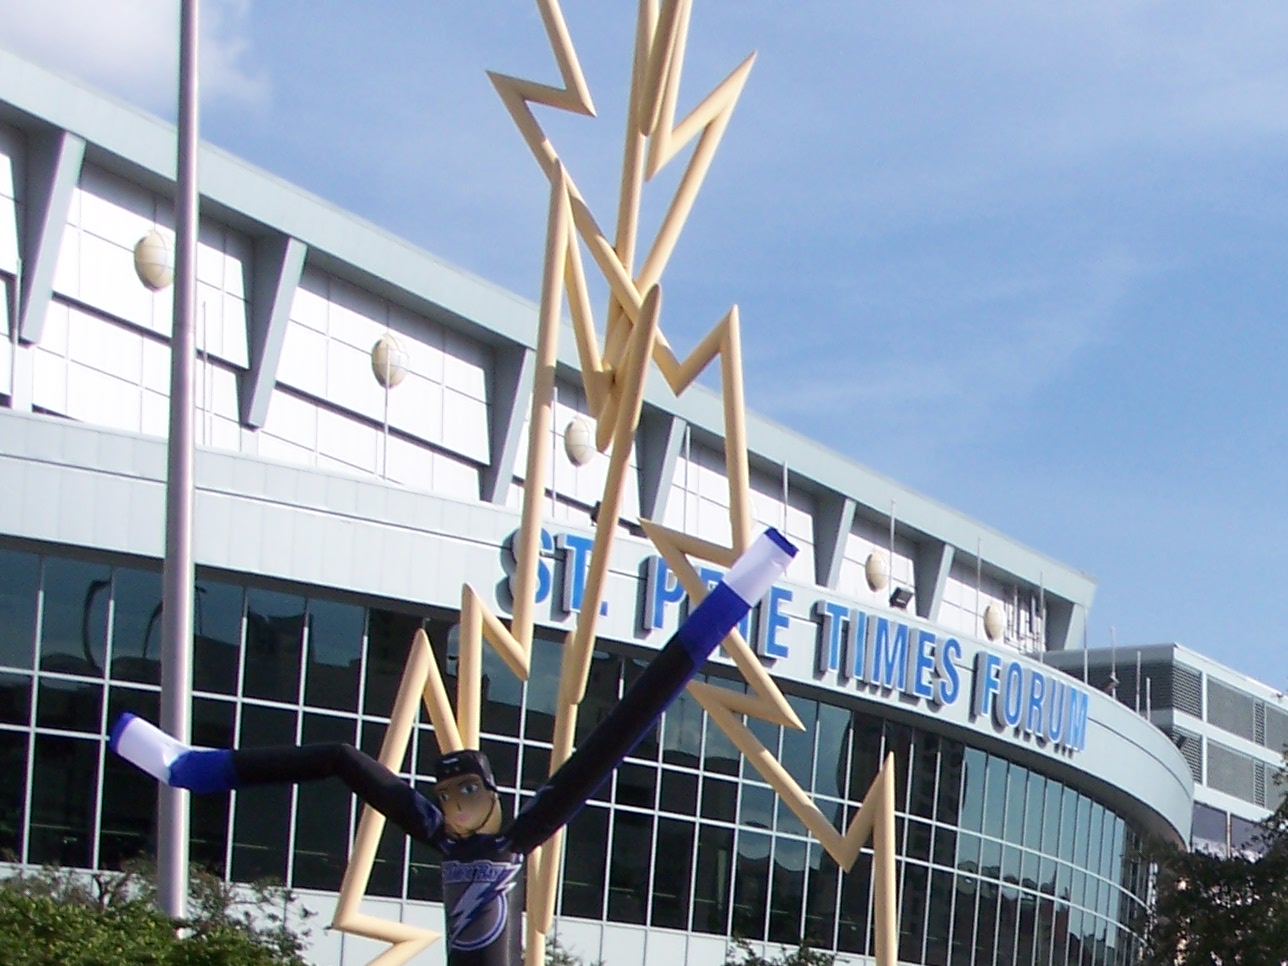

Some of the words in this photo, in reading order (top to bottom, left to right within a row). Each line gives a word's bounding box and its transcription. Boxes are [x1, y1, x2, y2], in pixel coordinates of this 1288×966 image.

[646, 555, 792, 657] PE
[818, 599, 961, 705] TIMES
[977, 650, 1089, 754] FORUM
